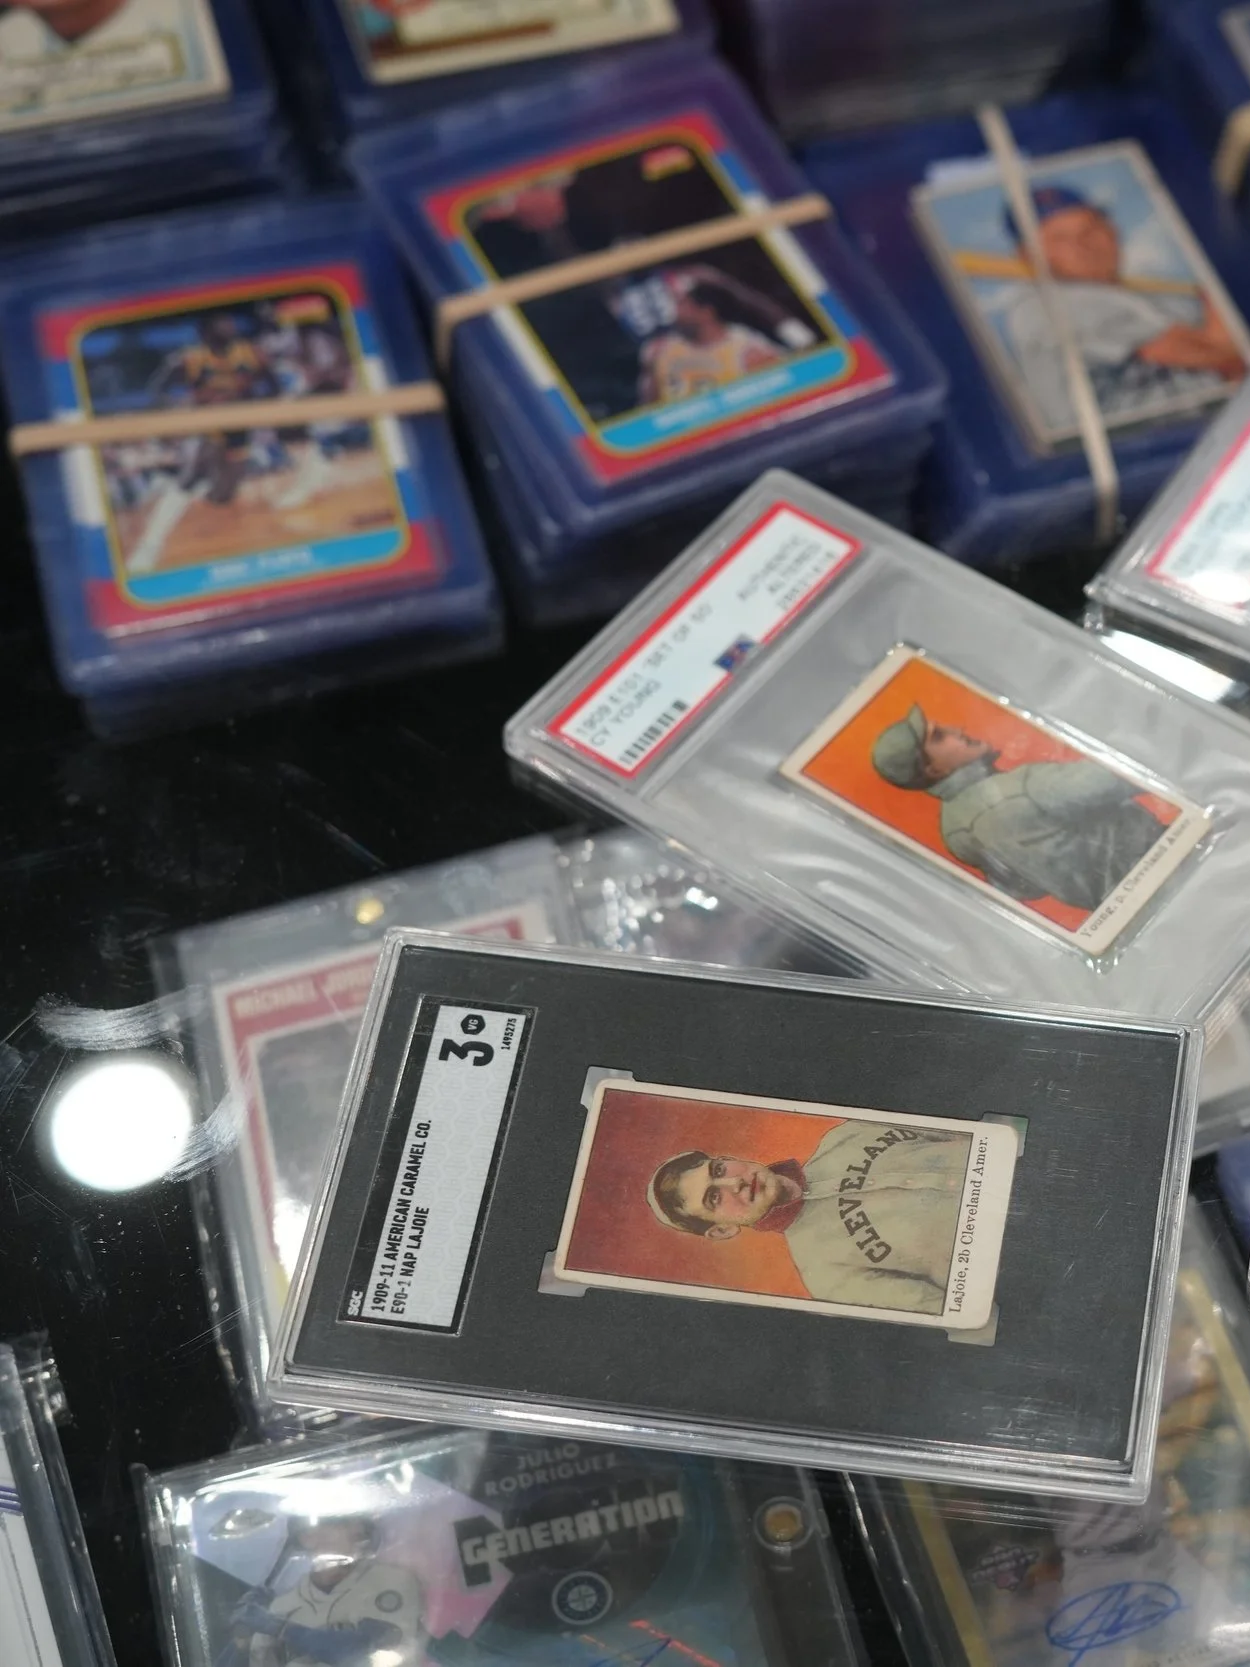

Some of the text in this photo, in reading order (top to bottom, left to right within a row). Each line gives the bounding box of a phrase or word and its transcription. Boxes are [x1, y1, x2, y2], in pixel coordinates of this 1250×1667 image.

[590, 680, 662, 747] CY YOUNG
[467, 1018, 479, 1031] VG
[501, 1017, 518, 1050] 1495275
[438, 1038, 495, 1067] 3
[371, 1119, 432, 1312] 1909-11 AMERICAN CARAMEL CO.
[838, 1128, 918, 1263] CLEVELAND
[949, 1136, 988, 1313] Lajoie, 2b Cleveland Amer.
[391, 1206, 430, 1316] E90-1 NAP LAJOIE
[347, 1289, 364, 1316] SGC
[484, 1453, 618, 1497] RODRIGUEZ
[517, 1442, 581, 1471] JULIO
